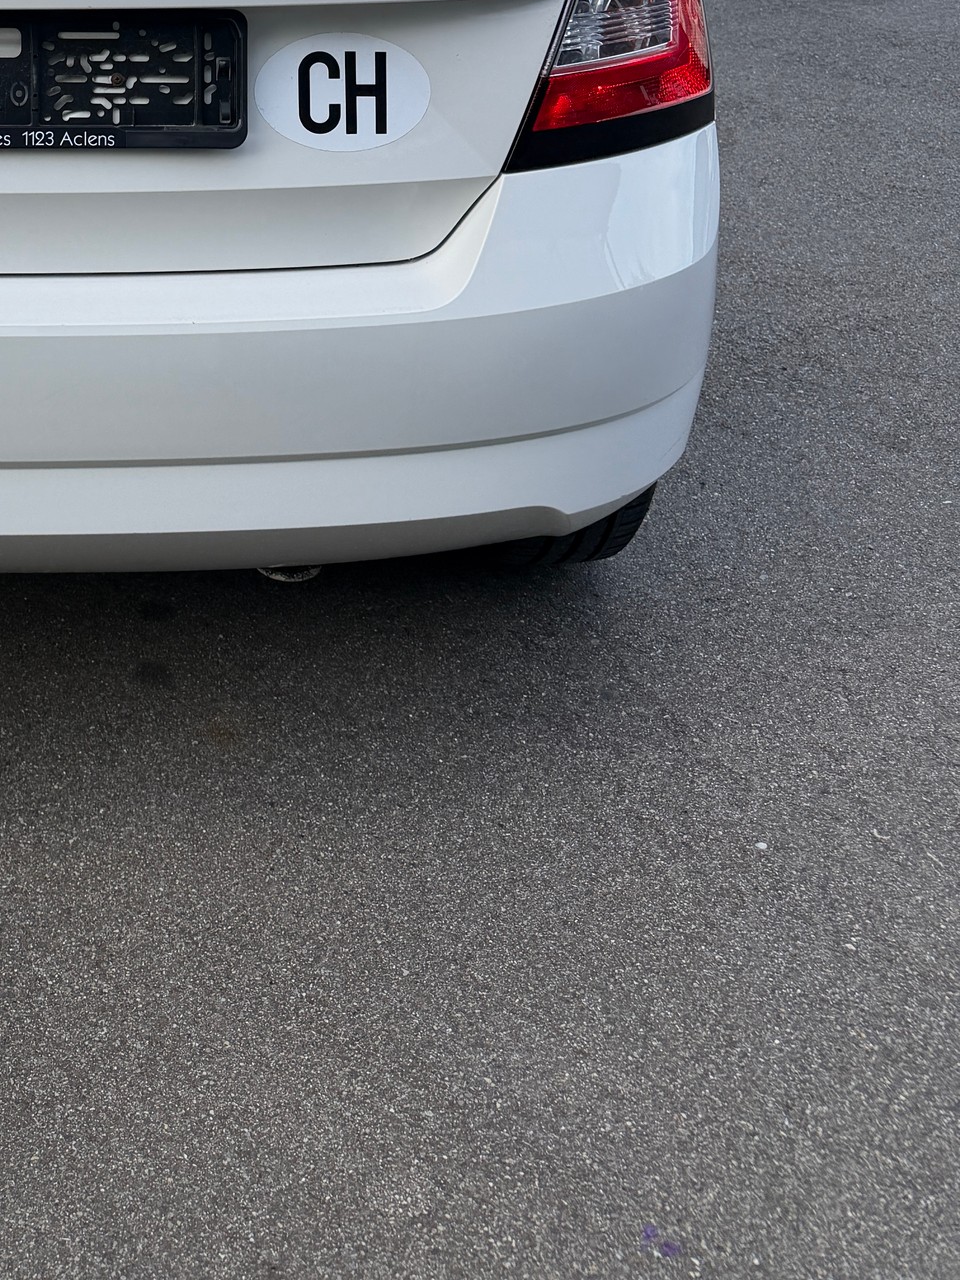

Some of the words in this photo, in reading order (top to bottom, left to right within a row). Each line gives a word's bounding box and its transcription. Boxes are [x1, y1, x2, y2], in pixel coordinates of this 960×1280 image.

[298, 51, 387, 134] CH
[21, 131, 55, 146] 1123
[60, 131, 115, 146] Aclens
